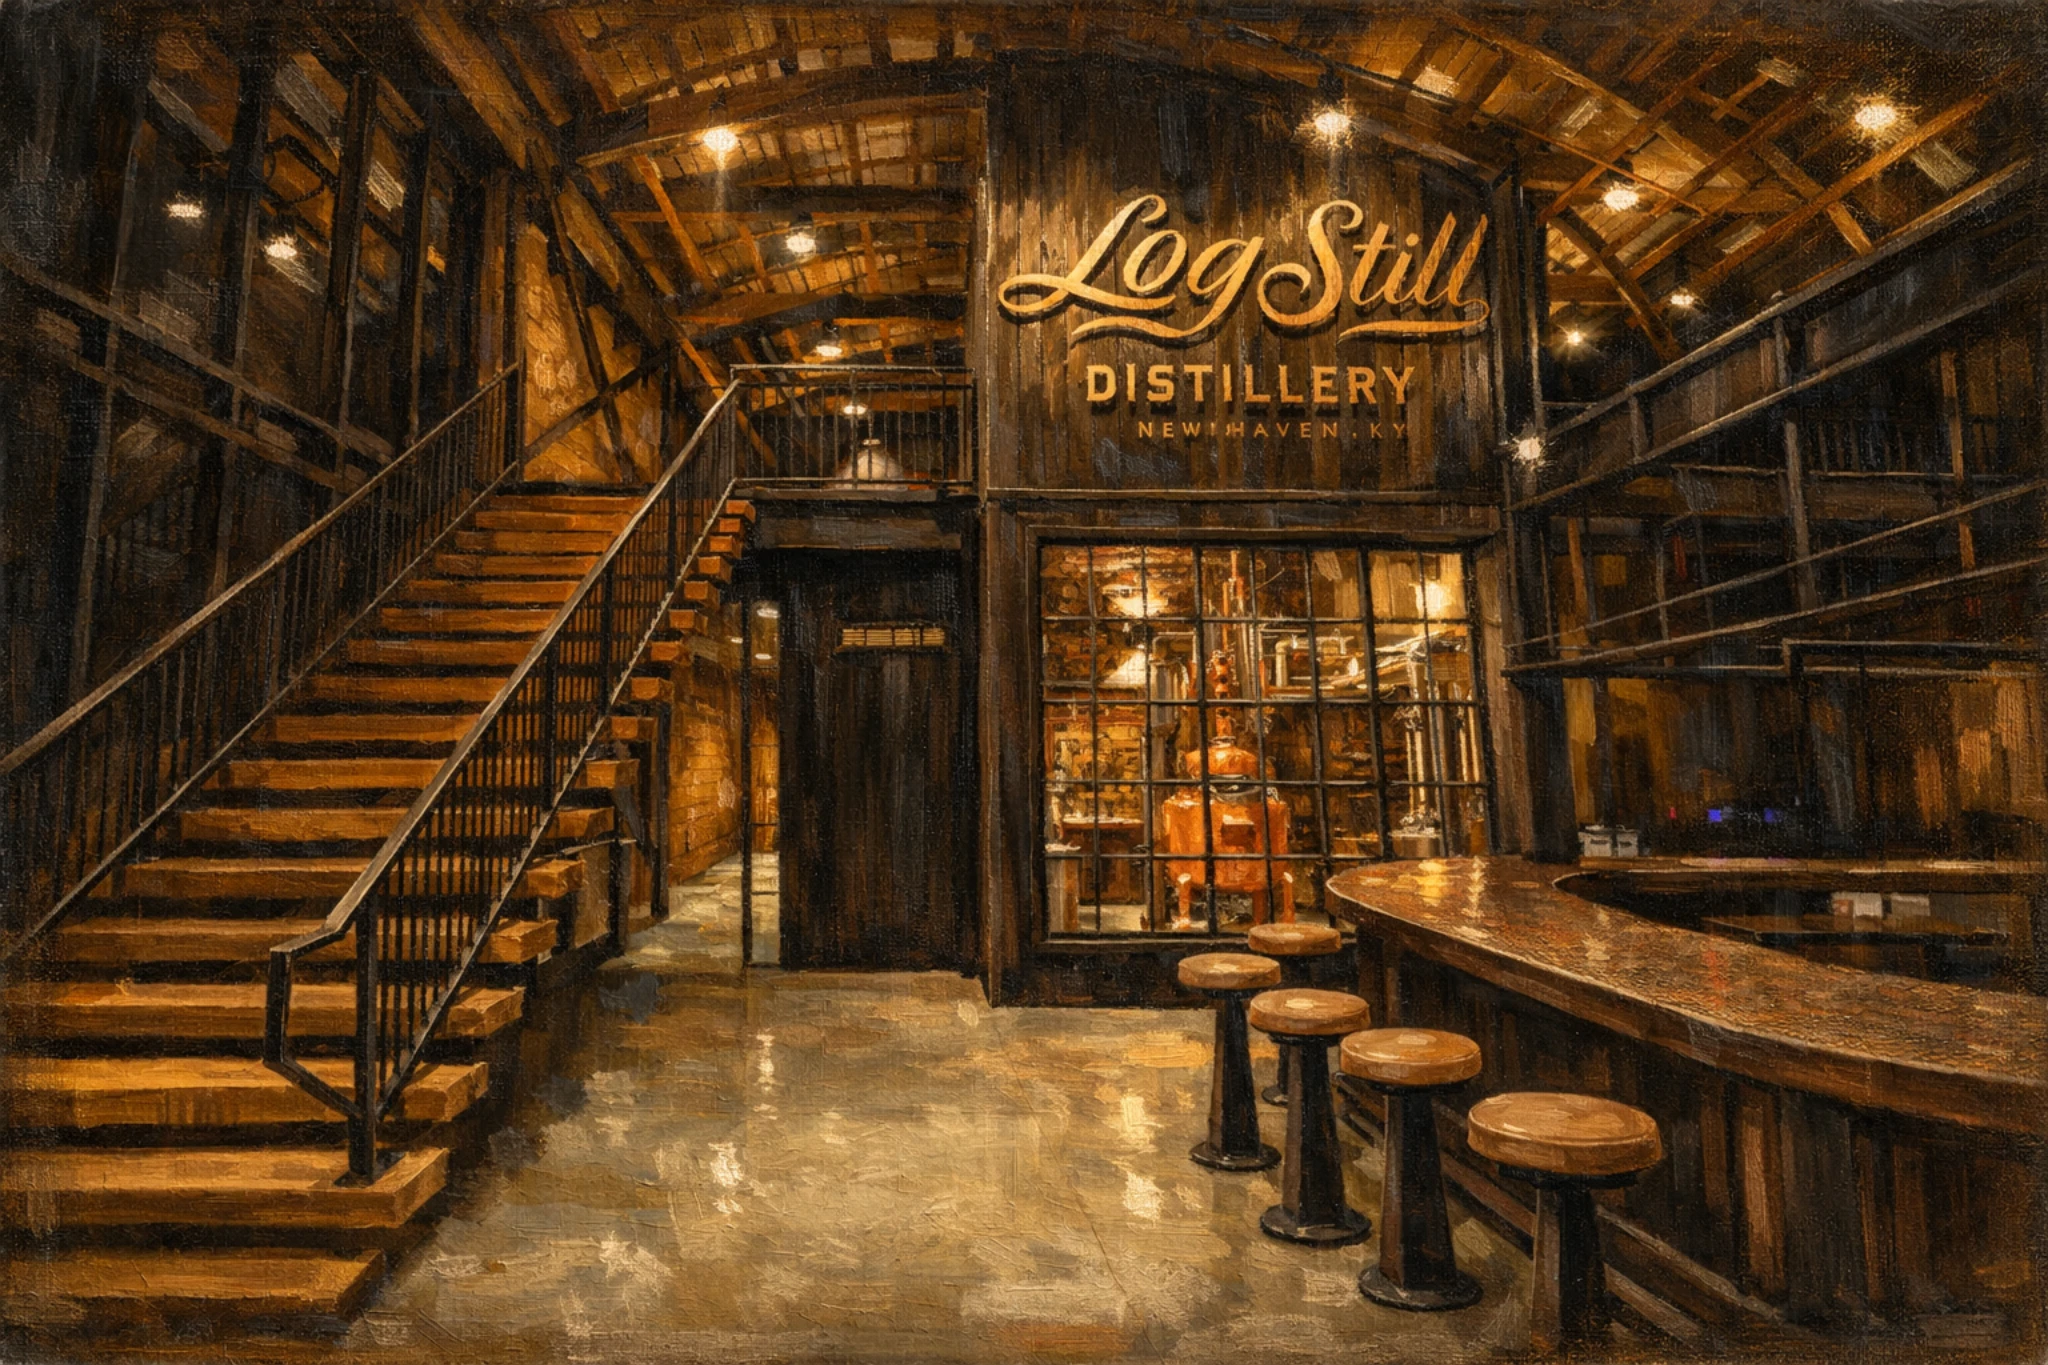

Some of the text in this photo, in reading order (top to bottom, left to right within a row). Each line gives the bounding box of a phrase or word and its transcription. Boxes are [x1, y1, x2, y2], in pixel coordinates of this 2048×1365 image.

[998, 194, 1489, 343] Log Still
[1086, 362, 1416, 404] DISTILLERY
[1138, 421, 1201, 438] NEW
[1370, 422, 1406, 439] KY
